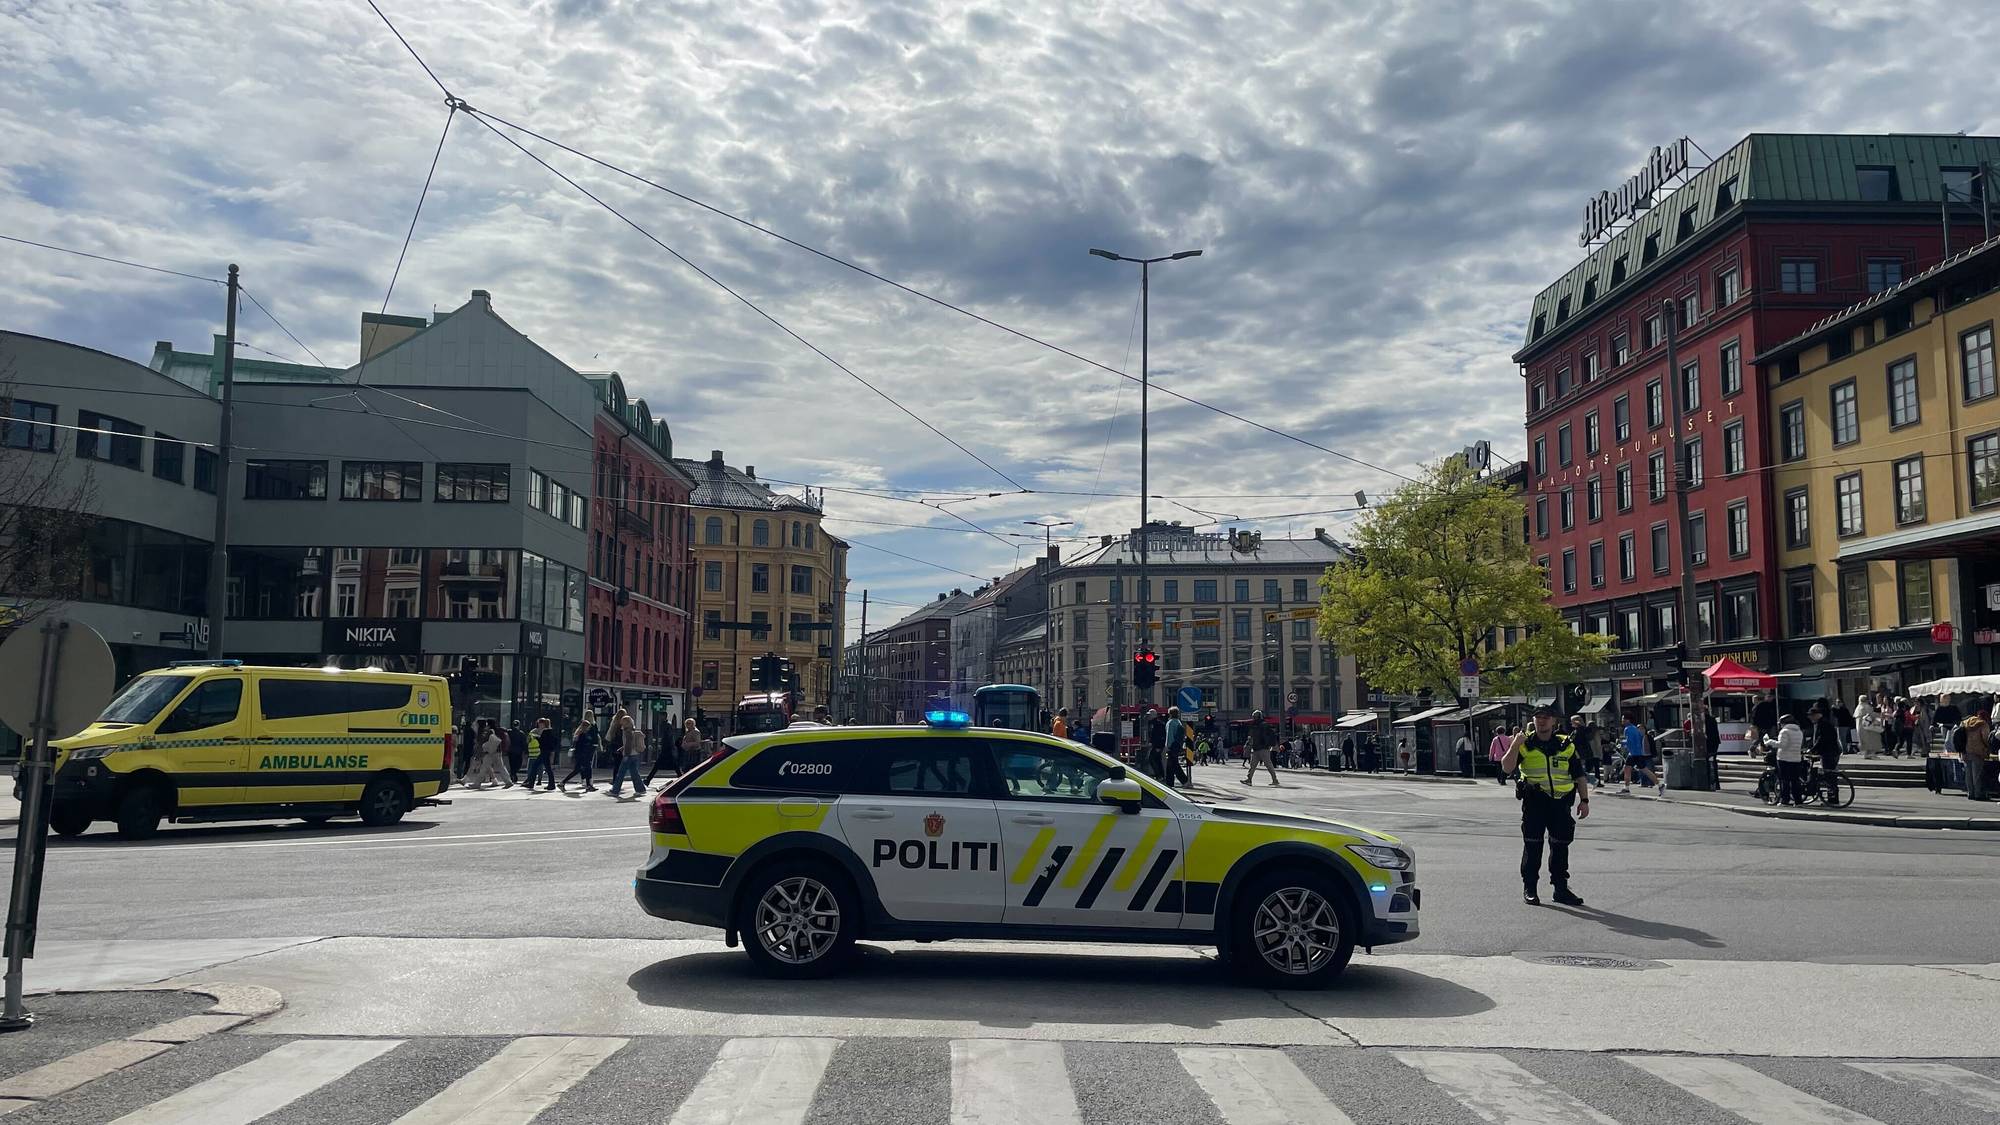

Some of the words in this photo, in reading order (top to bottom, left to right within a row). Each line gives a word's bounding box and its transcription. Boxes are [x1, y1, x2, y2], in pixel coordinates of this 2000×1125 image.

[346, 627, 396, 642] NIKITA
[1880, 640, 1913, 653] SAMSON
[1703, 654, 1719, 665] OLD
[1742, 650, 1758, 663] PUB
[410, 714, 439, 725] 113
[259, 755, 369, 769] AMBULANSE
[790, 763, 833, 775] 02800
[873, 838, 998, 872] POLITI
